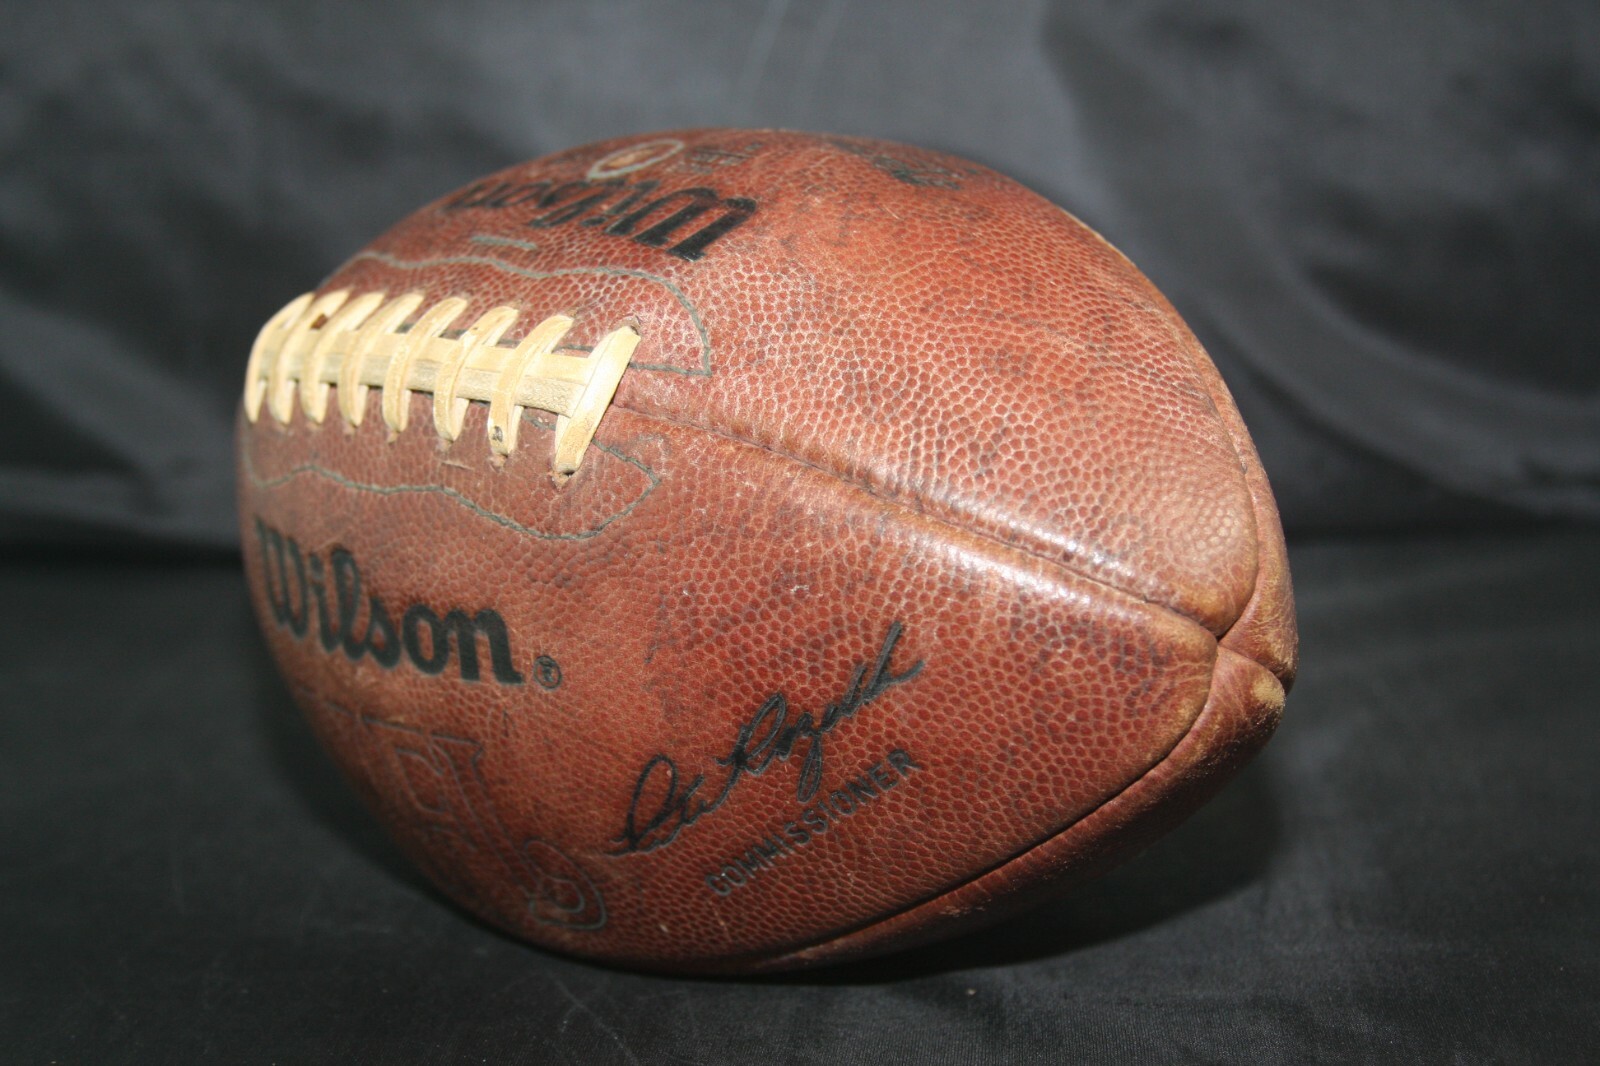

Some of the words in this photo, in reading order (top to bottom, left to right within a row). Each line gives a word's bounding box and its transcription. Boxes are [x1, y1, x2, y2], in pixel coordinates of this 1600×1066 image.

[438, 180, 757, 262] Wilson
[257, 518, 525, 685] Wilson
[704, 748, 923, 897] COMMISSIONER
